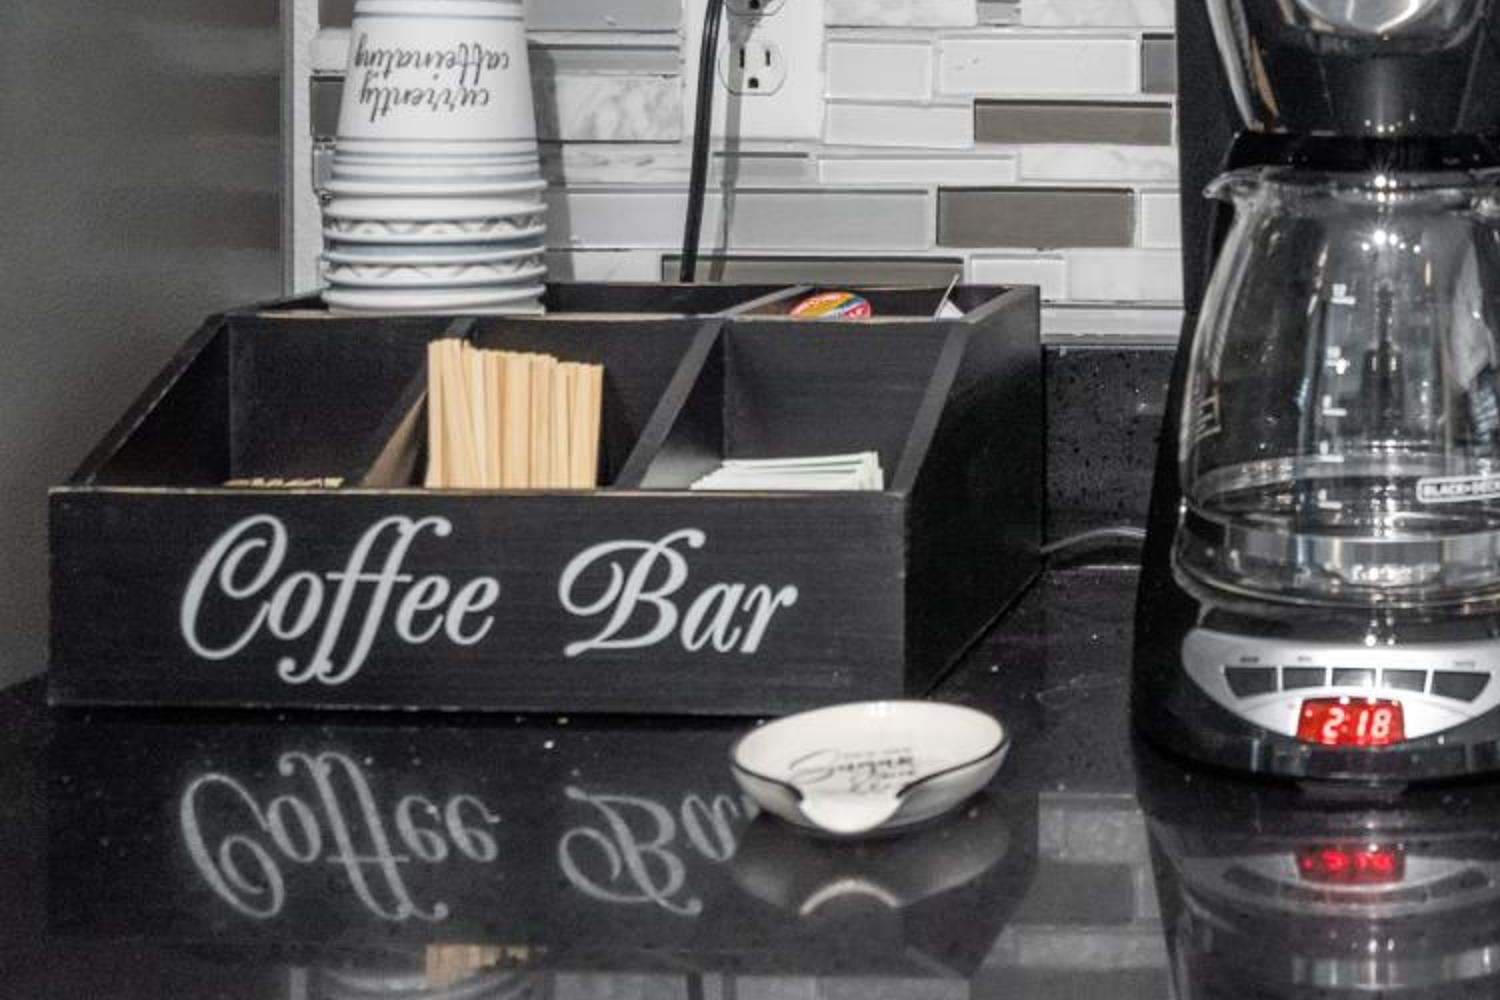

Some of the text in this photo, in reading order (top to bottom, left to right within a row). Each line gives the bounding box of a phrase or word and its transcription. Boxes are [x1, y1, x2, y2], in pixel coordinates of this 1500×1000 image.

[355, 33, 510, 87] caffeinating
[360, 70, 490, 124] currently
[179, 513, 799, 686] Coffee Bar
[1322, 706, 1393, 739] 2:18
